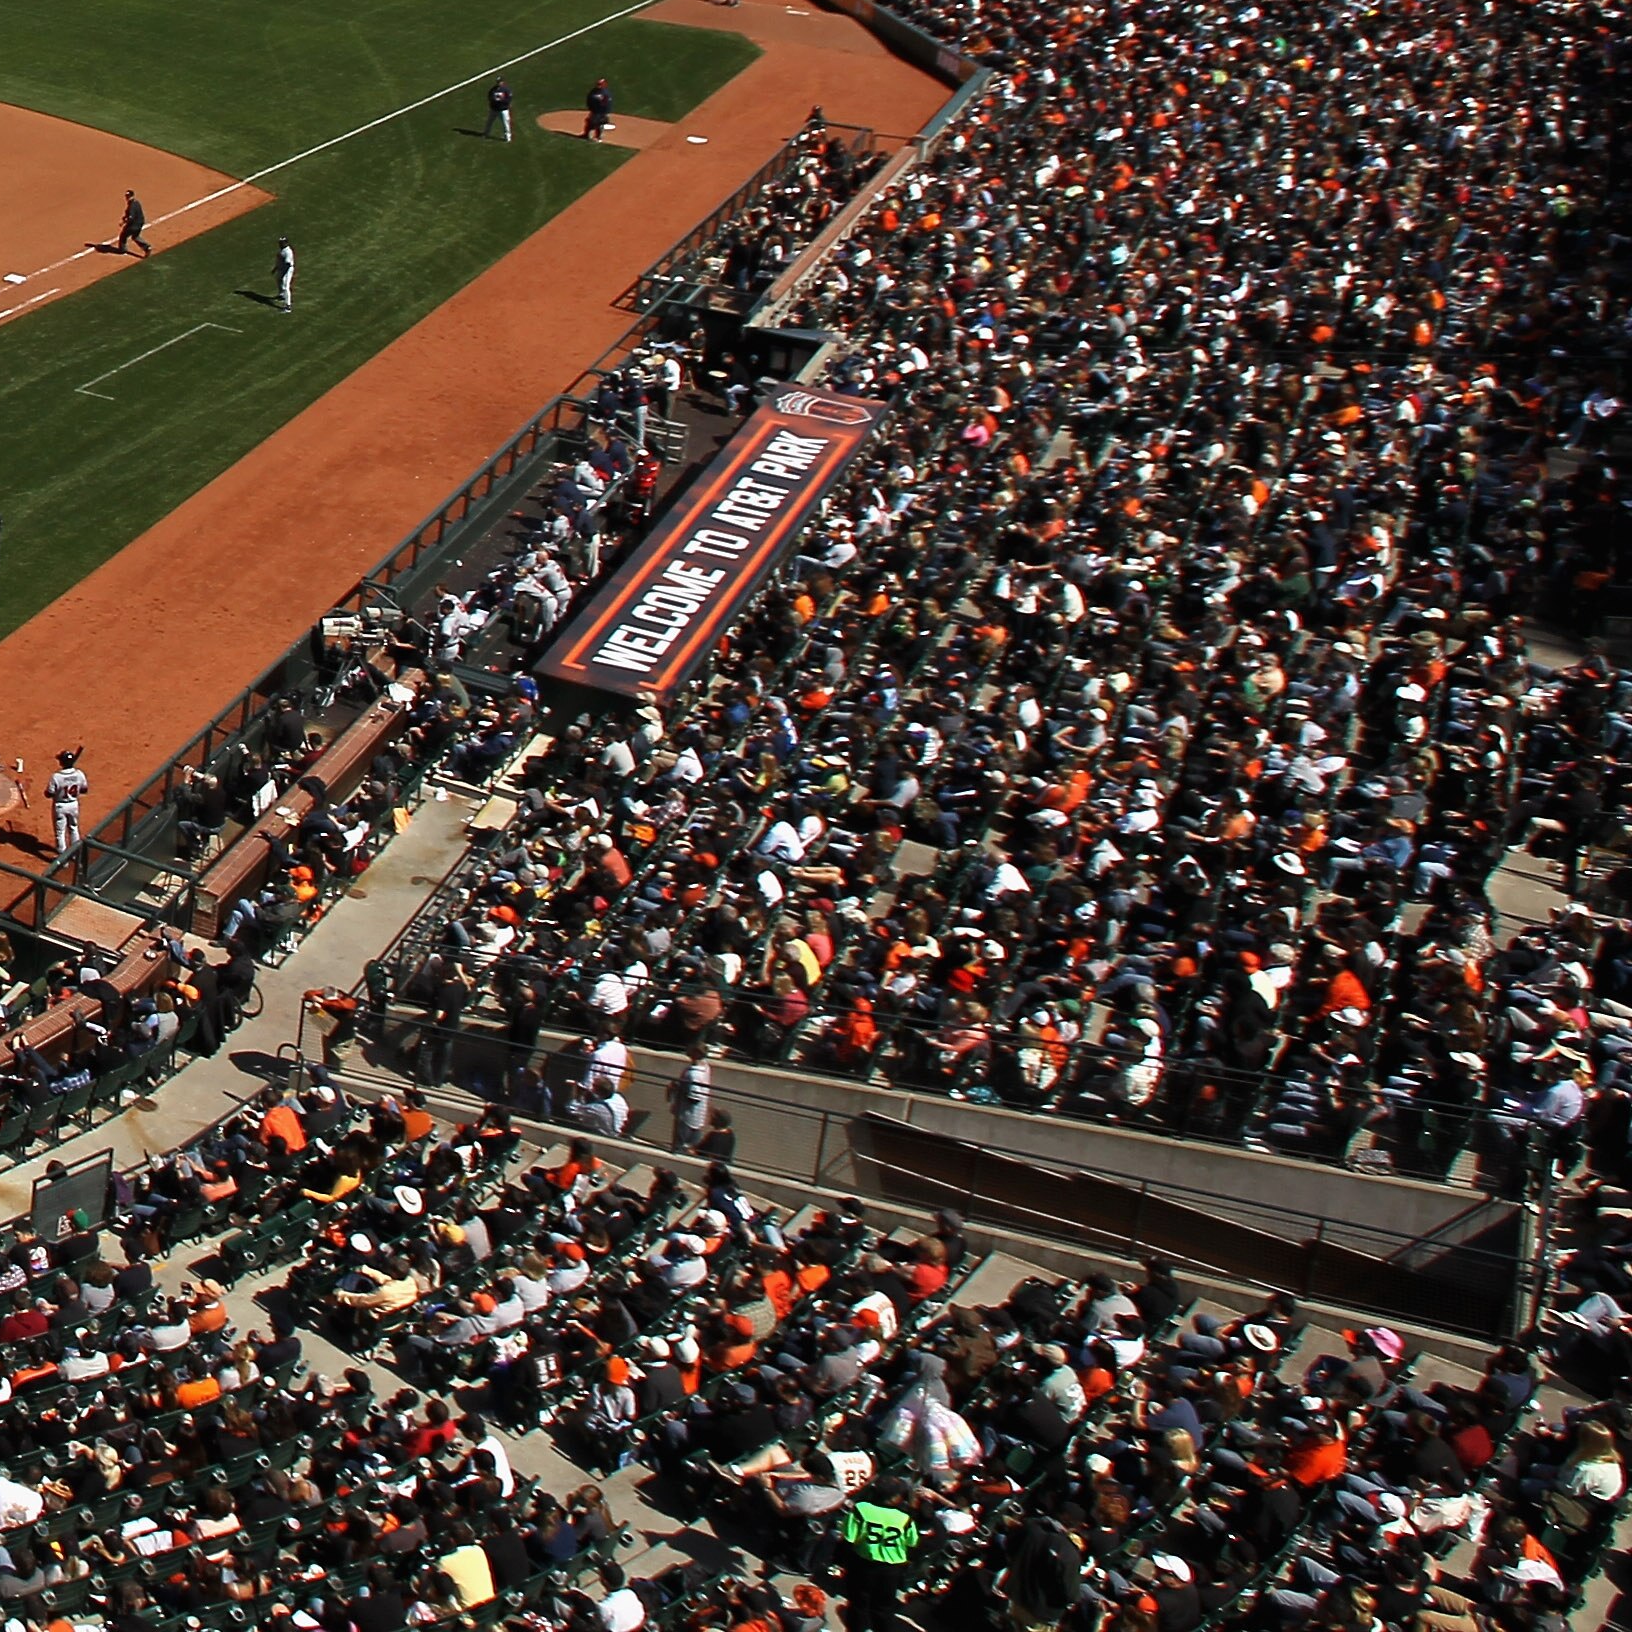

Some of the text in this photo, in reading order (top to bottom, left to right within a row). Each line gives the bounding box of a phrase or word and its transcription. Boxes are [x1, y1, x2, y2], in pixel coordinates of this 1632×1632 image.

[750, 430, 830, 481] PARK
[711, 477, 789, 533] AT&T
[682, 528, 750, 560] TO
[592, 560, 726, 673] WELCOME
[60, 783, 79, 798] 14
[866, 1521, 902, 1548] 52
